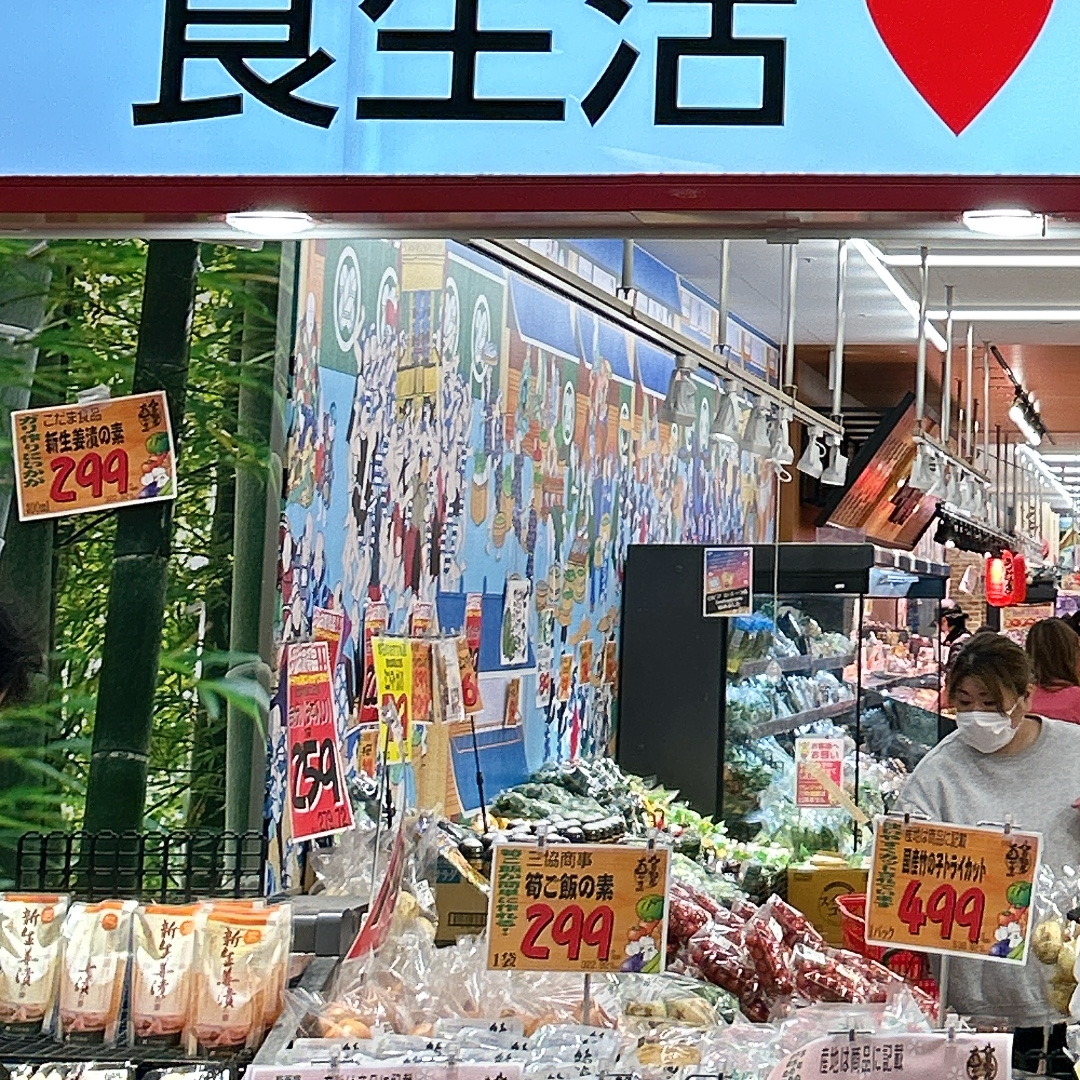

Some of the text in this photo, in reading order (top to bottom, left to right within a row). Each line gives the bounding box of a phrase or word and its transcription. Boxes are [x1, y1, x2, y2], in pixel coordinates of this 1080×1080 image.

[43, 408, 103, 427] こだま食品
[45, 422, 125, 454] 新生姜漬の素
[50, 448, 130, 503] 299
[291, 738, 343, 813] 259
[526, 850, 593, 869] 三協商事
[525, 871, 615, 902] 筍ご飯の素
[520, 902, 615, 962] 299
[898, 879, 986, 945] 499
